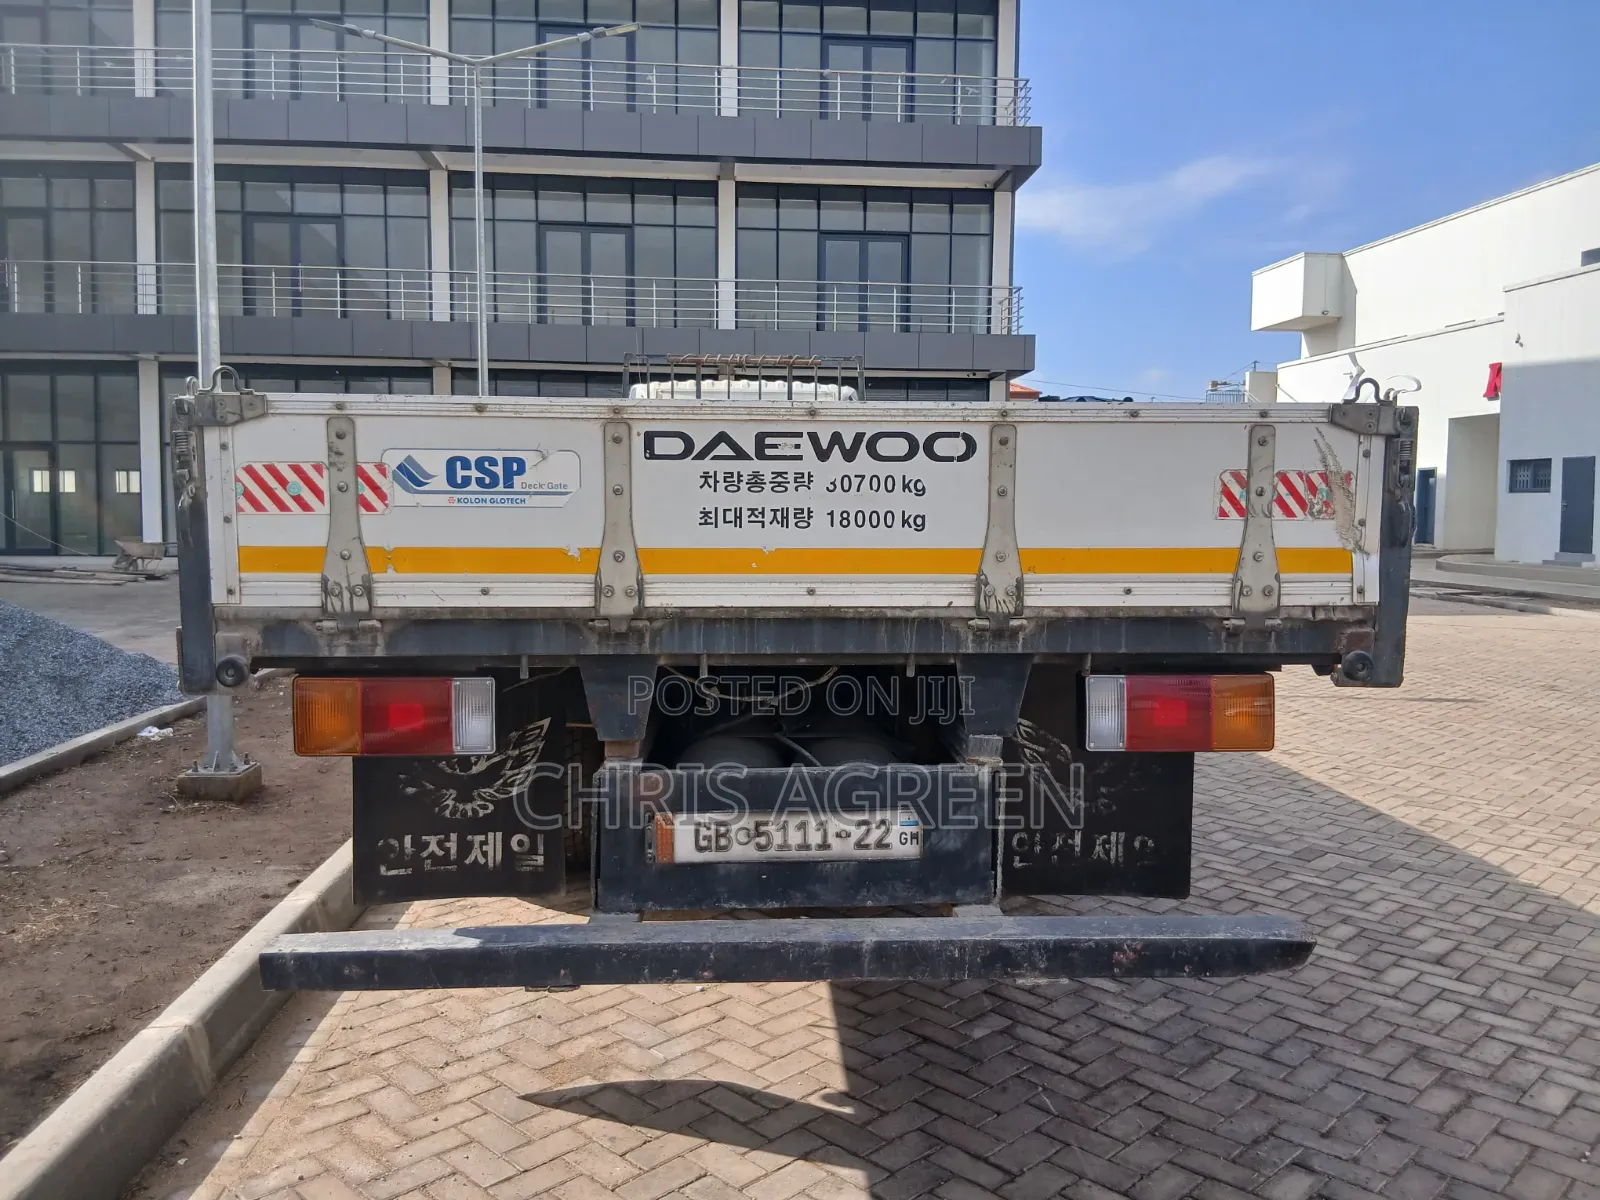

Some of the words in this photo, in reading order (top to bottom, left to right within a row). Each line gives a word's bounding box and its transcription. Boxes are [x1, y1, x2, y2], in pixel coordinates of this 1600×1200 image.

[643, 430, 977, 463] DAEWOO
[445, 455, 527, 490] CSP
[698, 469, 814, 494] 차량총중량
[520, 481, 546, 490] Deck
[547, 481, 568, 490] Gate
[456, 496, 487, 505] KOLON
[489, 496, 526, 505] GLOTECH
[698, 506, 814, 530] 최대적재량
[899, 831, 920, 846] GH
[377, 832, 545, 876] 안전제일
